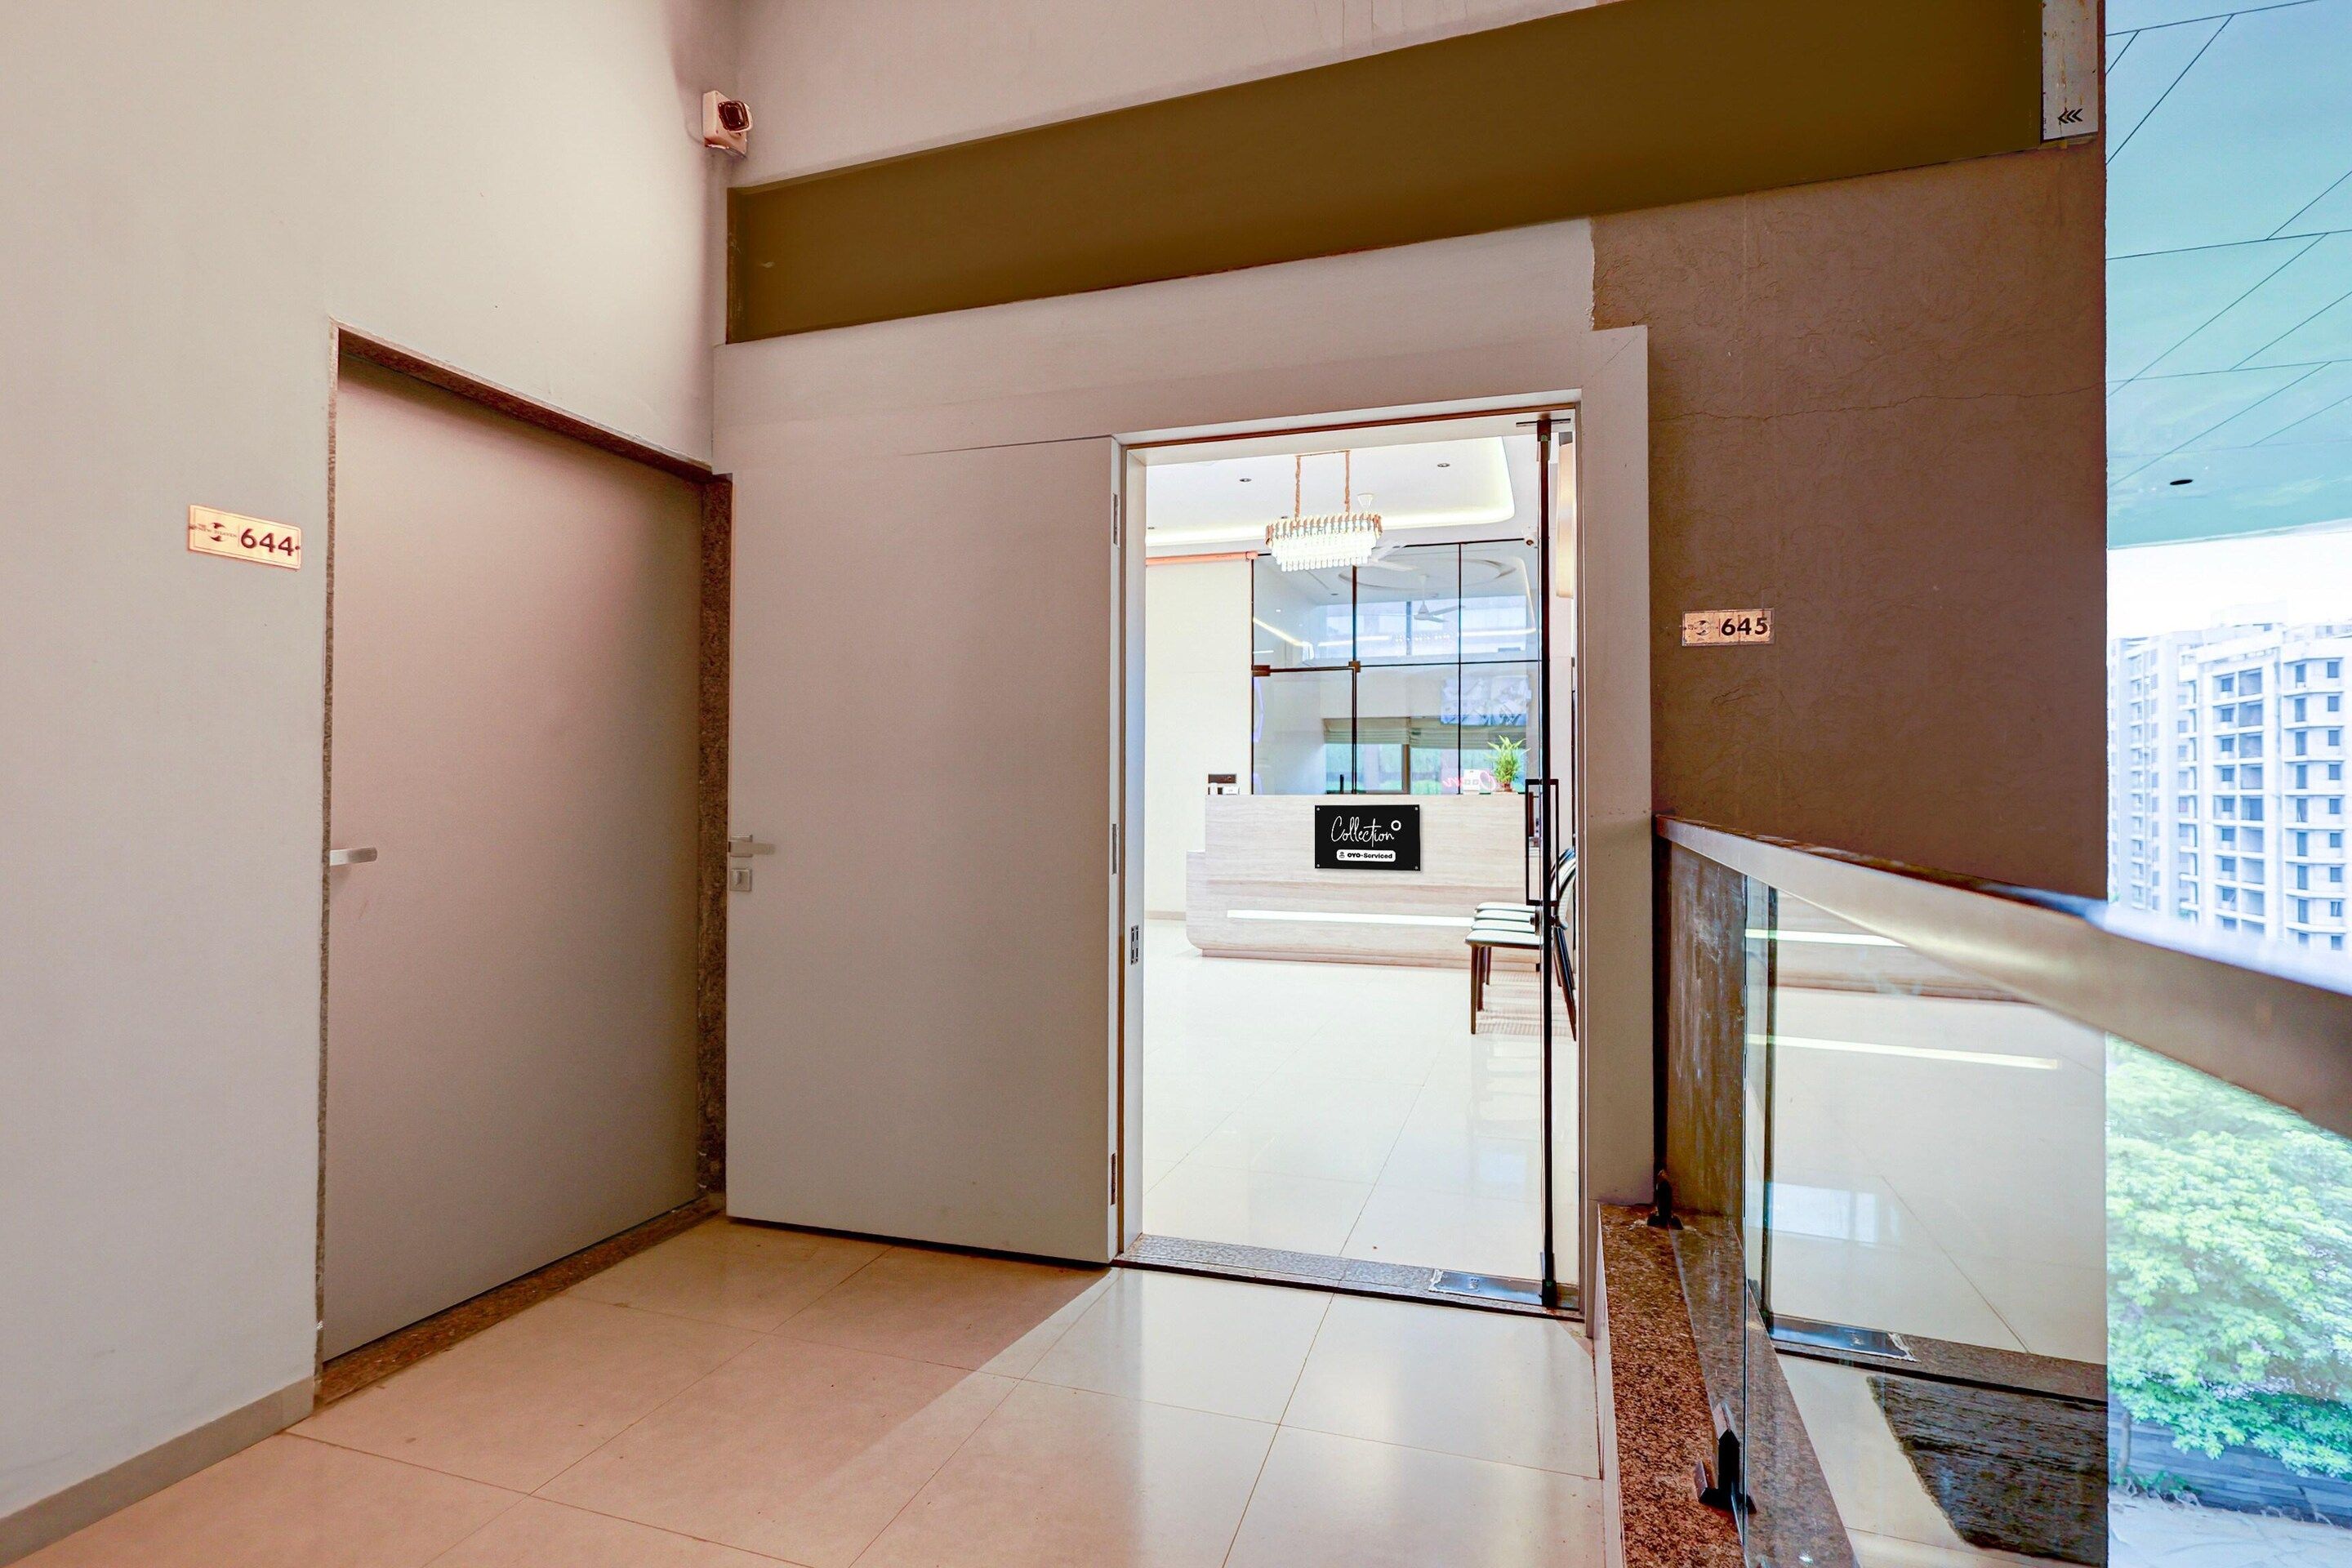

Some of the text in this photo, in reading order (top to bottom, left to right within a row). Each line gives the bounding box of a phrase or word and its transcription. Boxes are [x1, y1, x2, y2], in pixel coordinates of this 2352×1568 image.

[240, 528, 295, 557] 644
[1721, 617, 1769, 636] 645
[1330, 815, 1395, 848] Collection
[1347, 851, 1393, 859] OYO-Serviced
